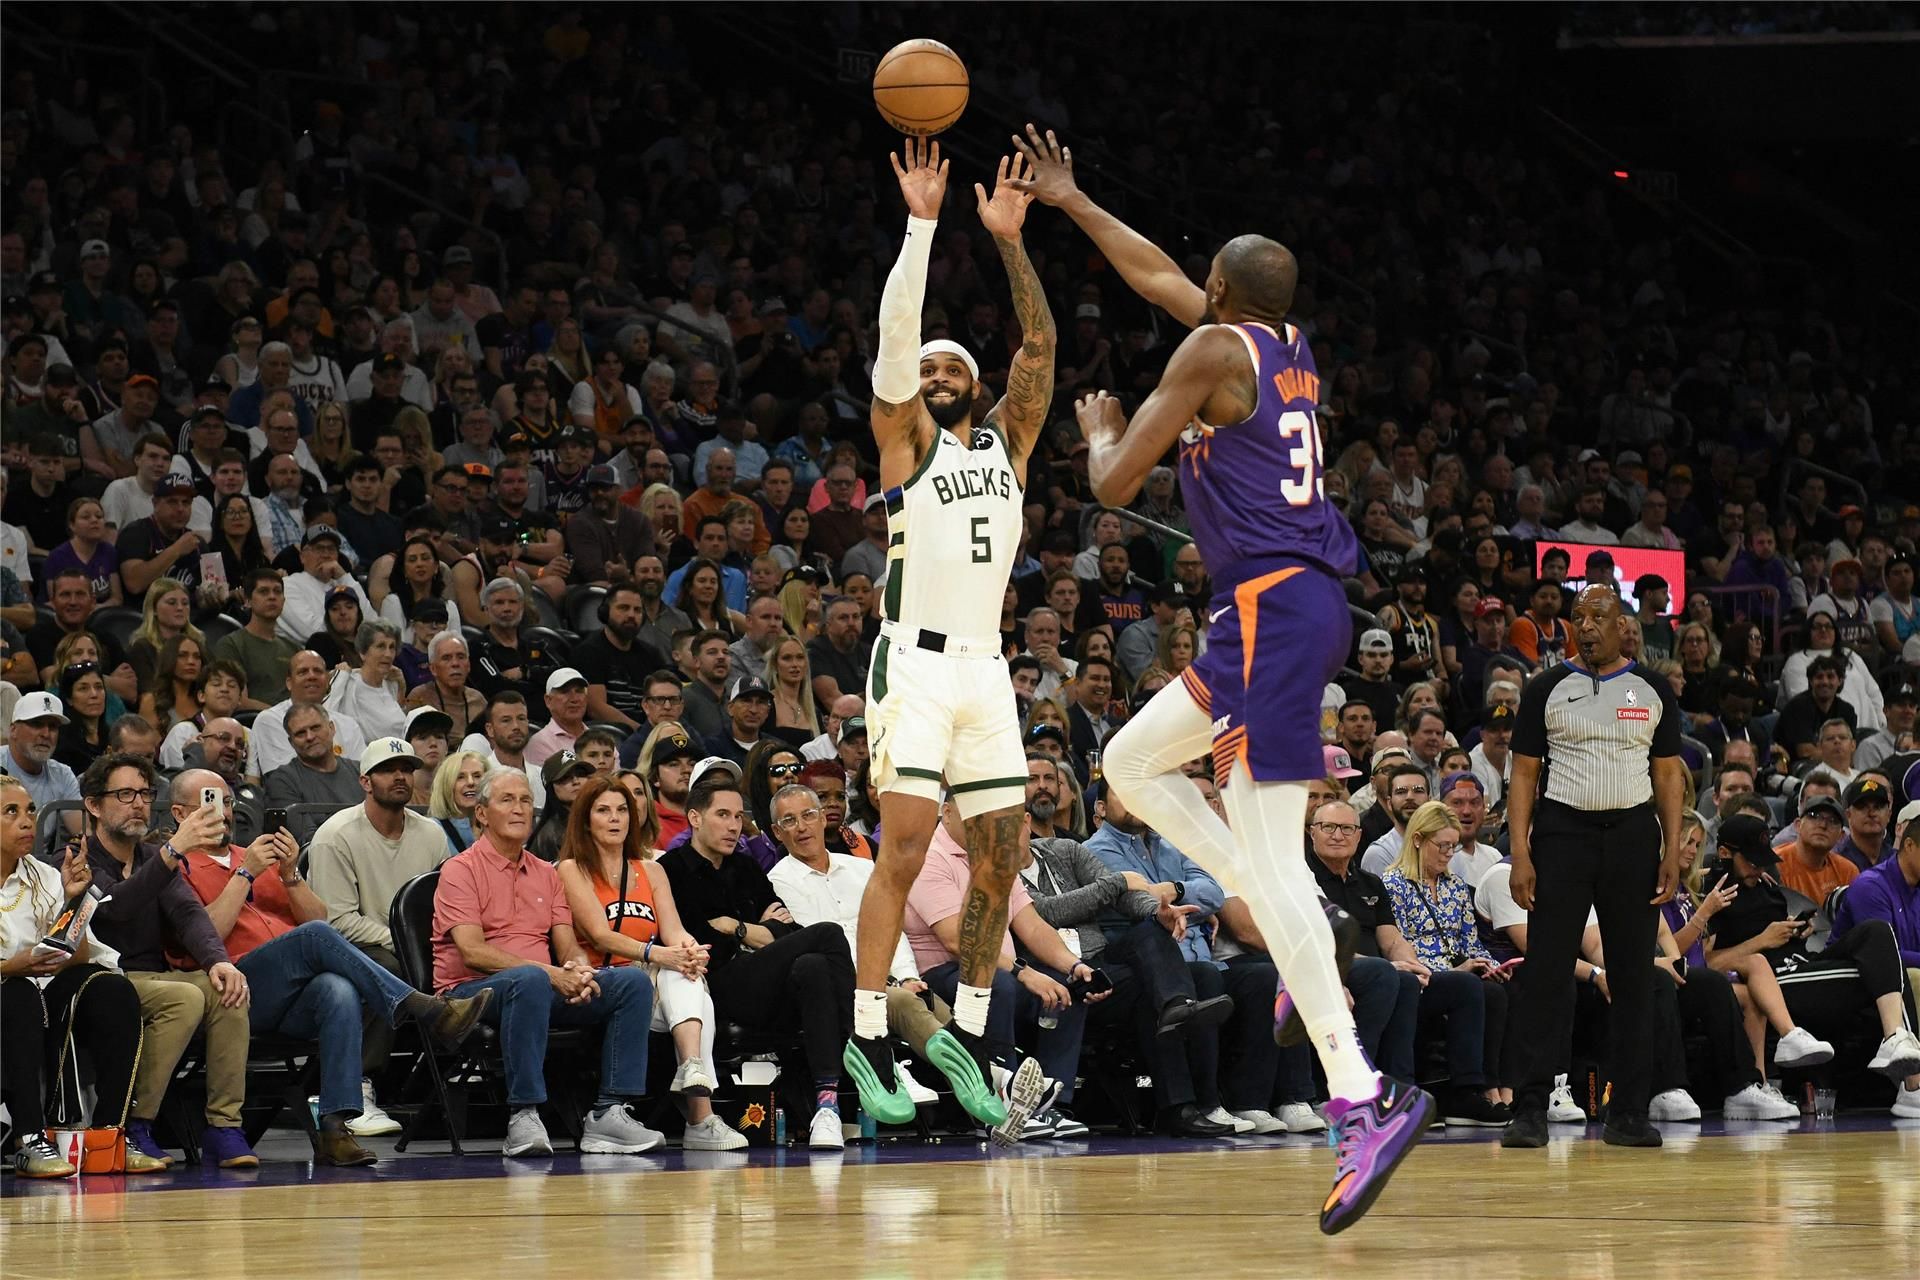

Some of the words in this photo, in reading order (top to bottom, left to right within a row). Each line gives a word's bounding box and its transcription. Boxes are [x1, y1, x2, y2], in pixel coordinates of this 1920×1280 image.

[1273, 367, 1320, 405] DURANT
[932, 467, 1010, 506] BUCKS
[970, 516, 992, 563] 5
[1617, 710, 1649, 719] Emirates
[389, 740, 404, 753] NY
[70, 900, 92, 943] POPCORN
[606, 902, 655, 921] PHX
